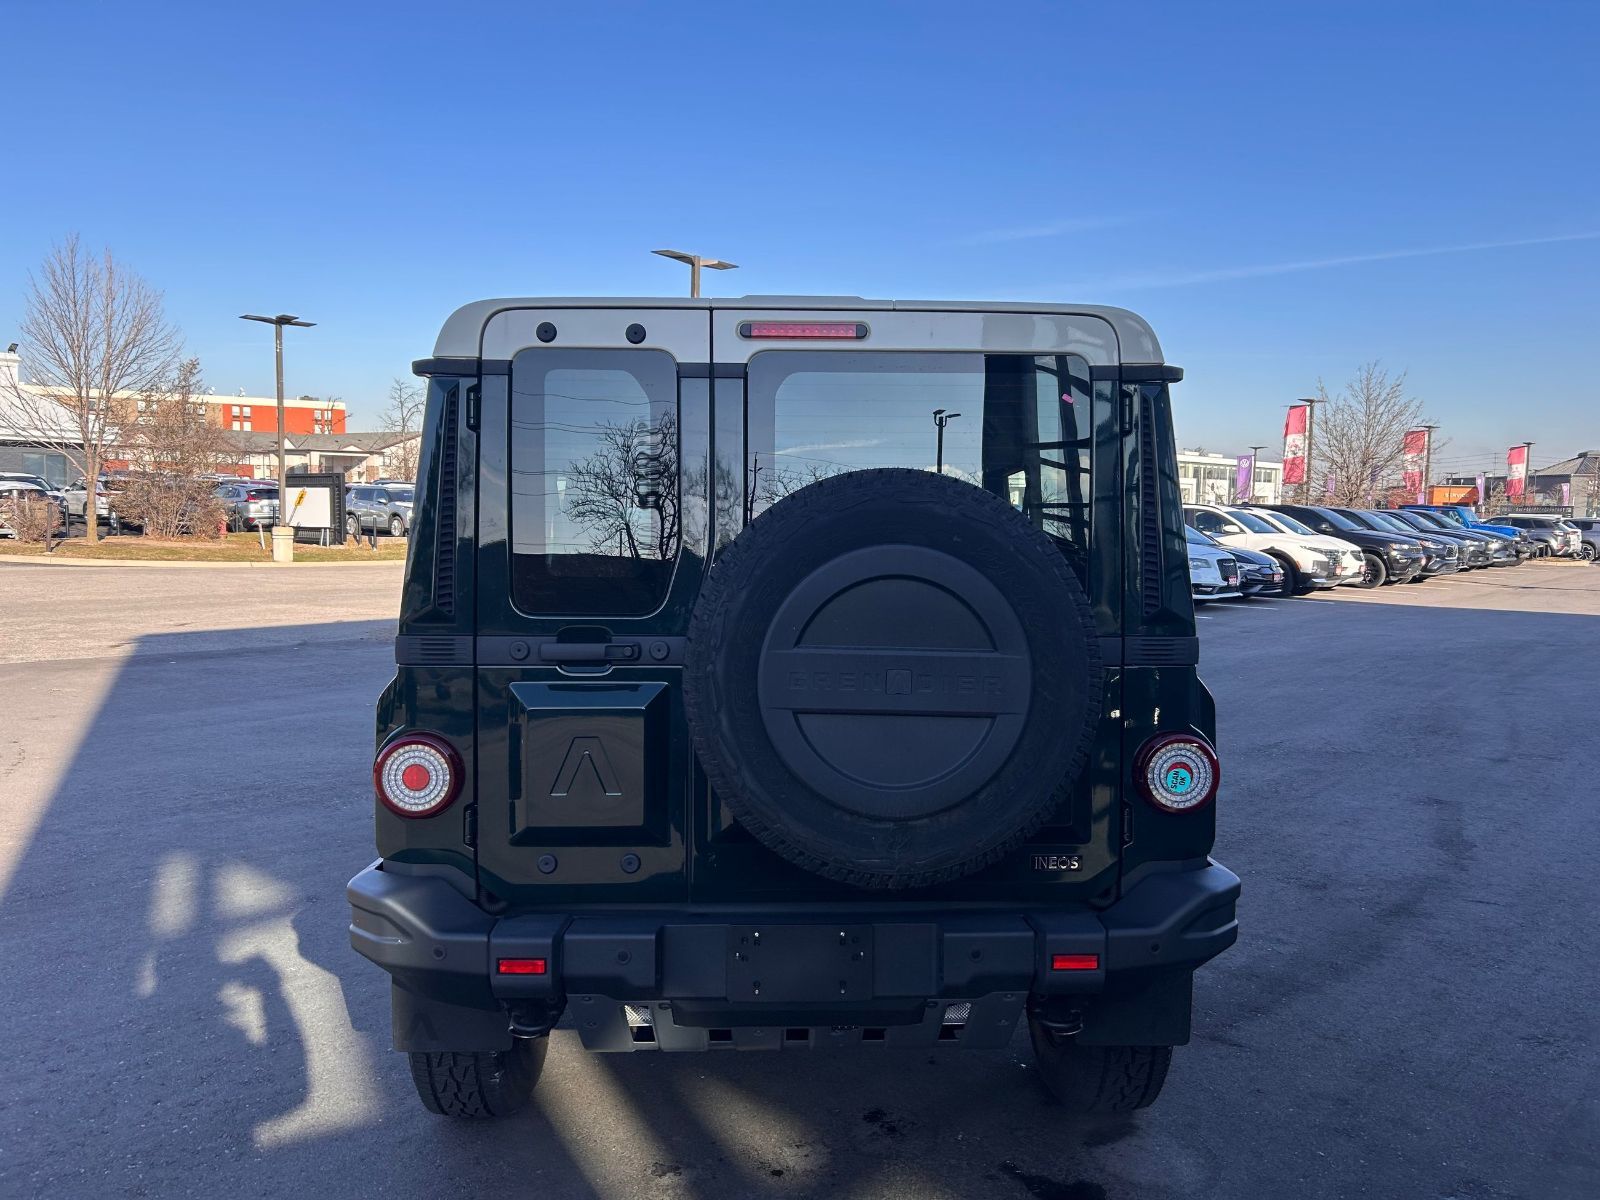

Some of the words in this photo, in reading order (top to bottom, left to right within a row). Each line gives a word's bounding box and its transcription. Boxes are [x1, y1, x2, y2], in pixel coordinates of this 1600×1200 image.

[786, 670, 1003, 695] GRENADIER
[1171, 770, 1180, 789] SCAN
[1179, 776, 1187, 786] OK
[1034, 856, 1080, 870] INEOS
